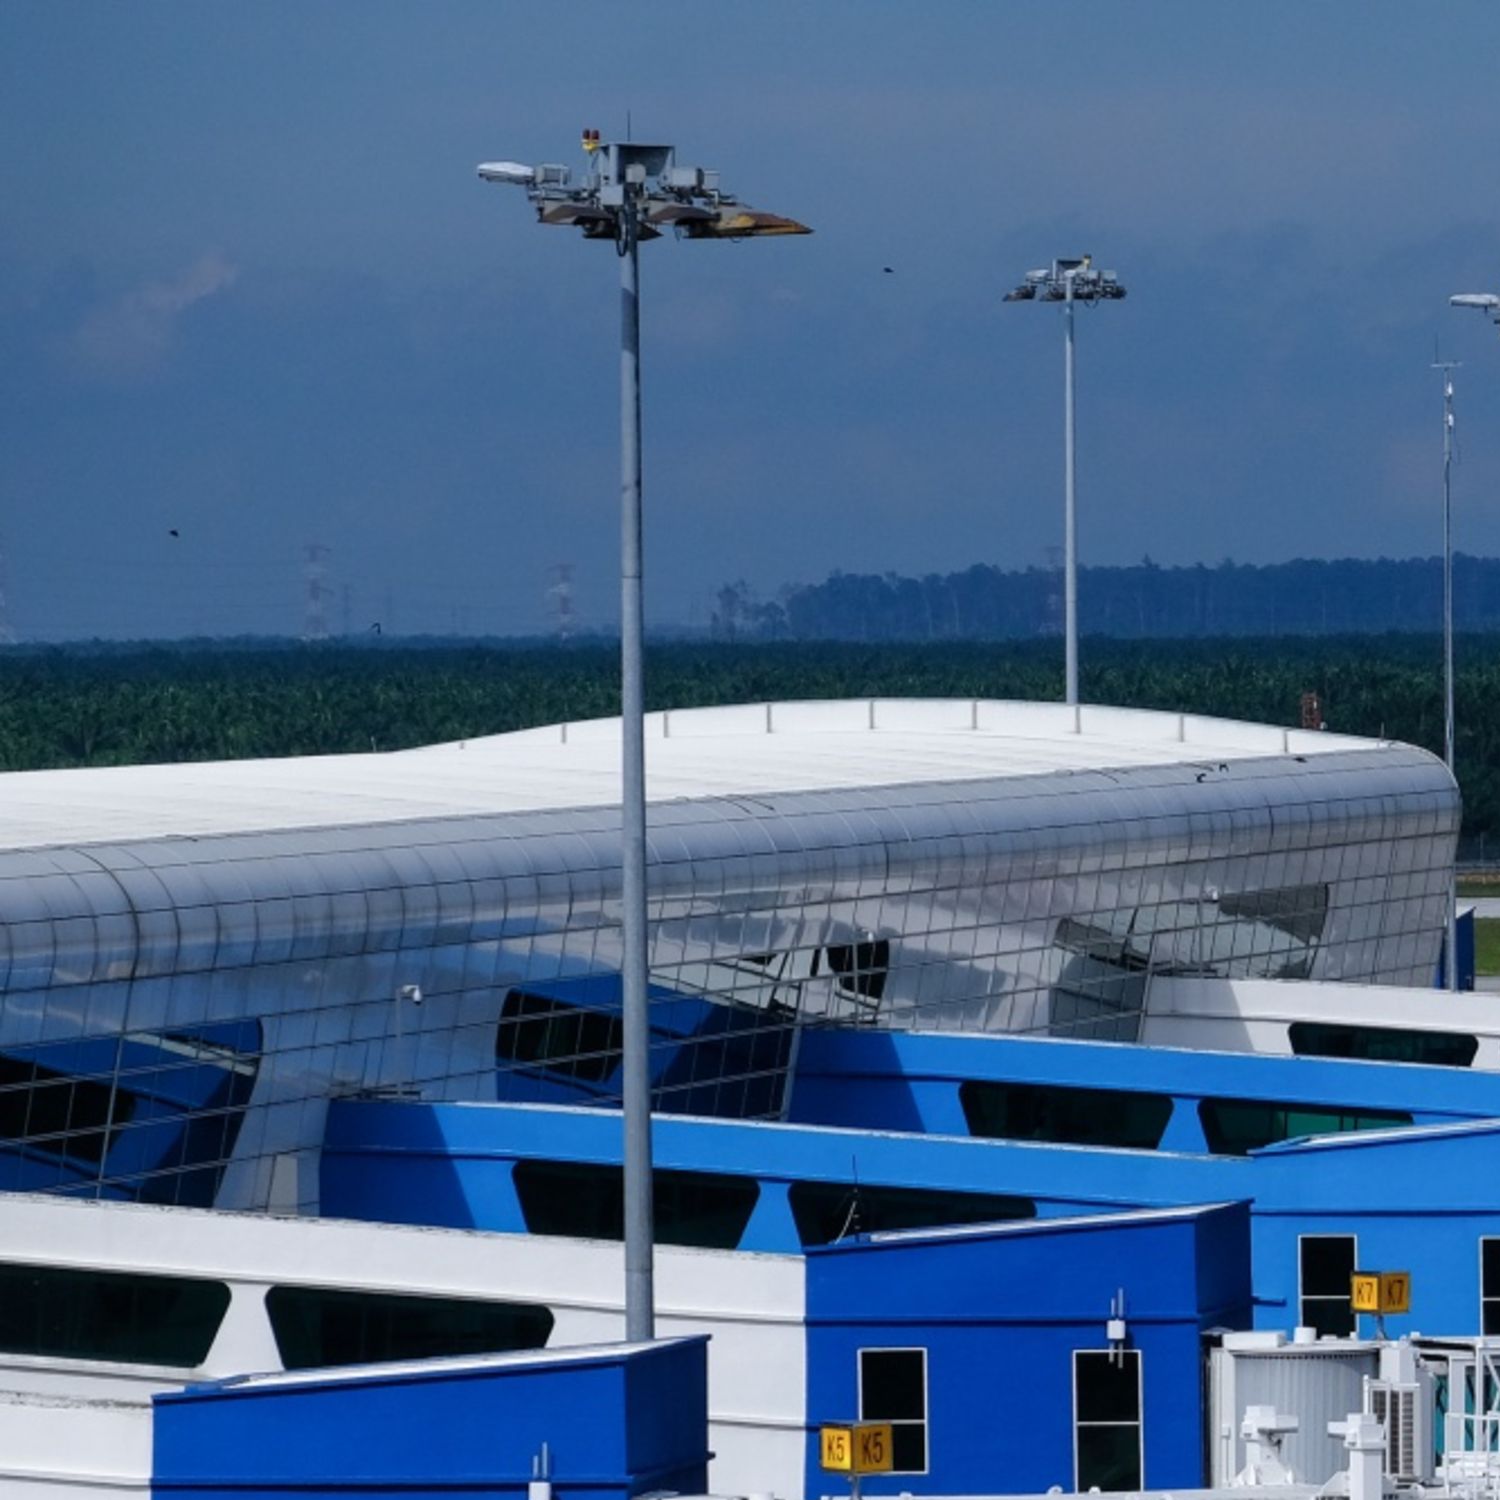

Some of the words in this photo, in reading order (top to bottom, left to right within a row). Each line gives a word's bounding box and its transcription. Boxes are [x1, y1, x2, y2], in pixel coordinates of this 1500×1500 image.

[1356, 1280, 1373, 1305] K7
[827, 1434, 845, 1463] K5
[861, 1430, 884, 1466] K5
